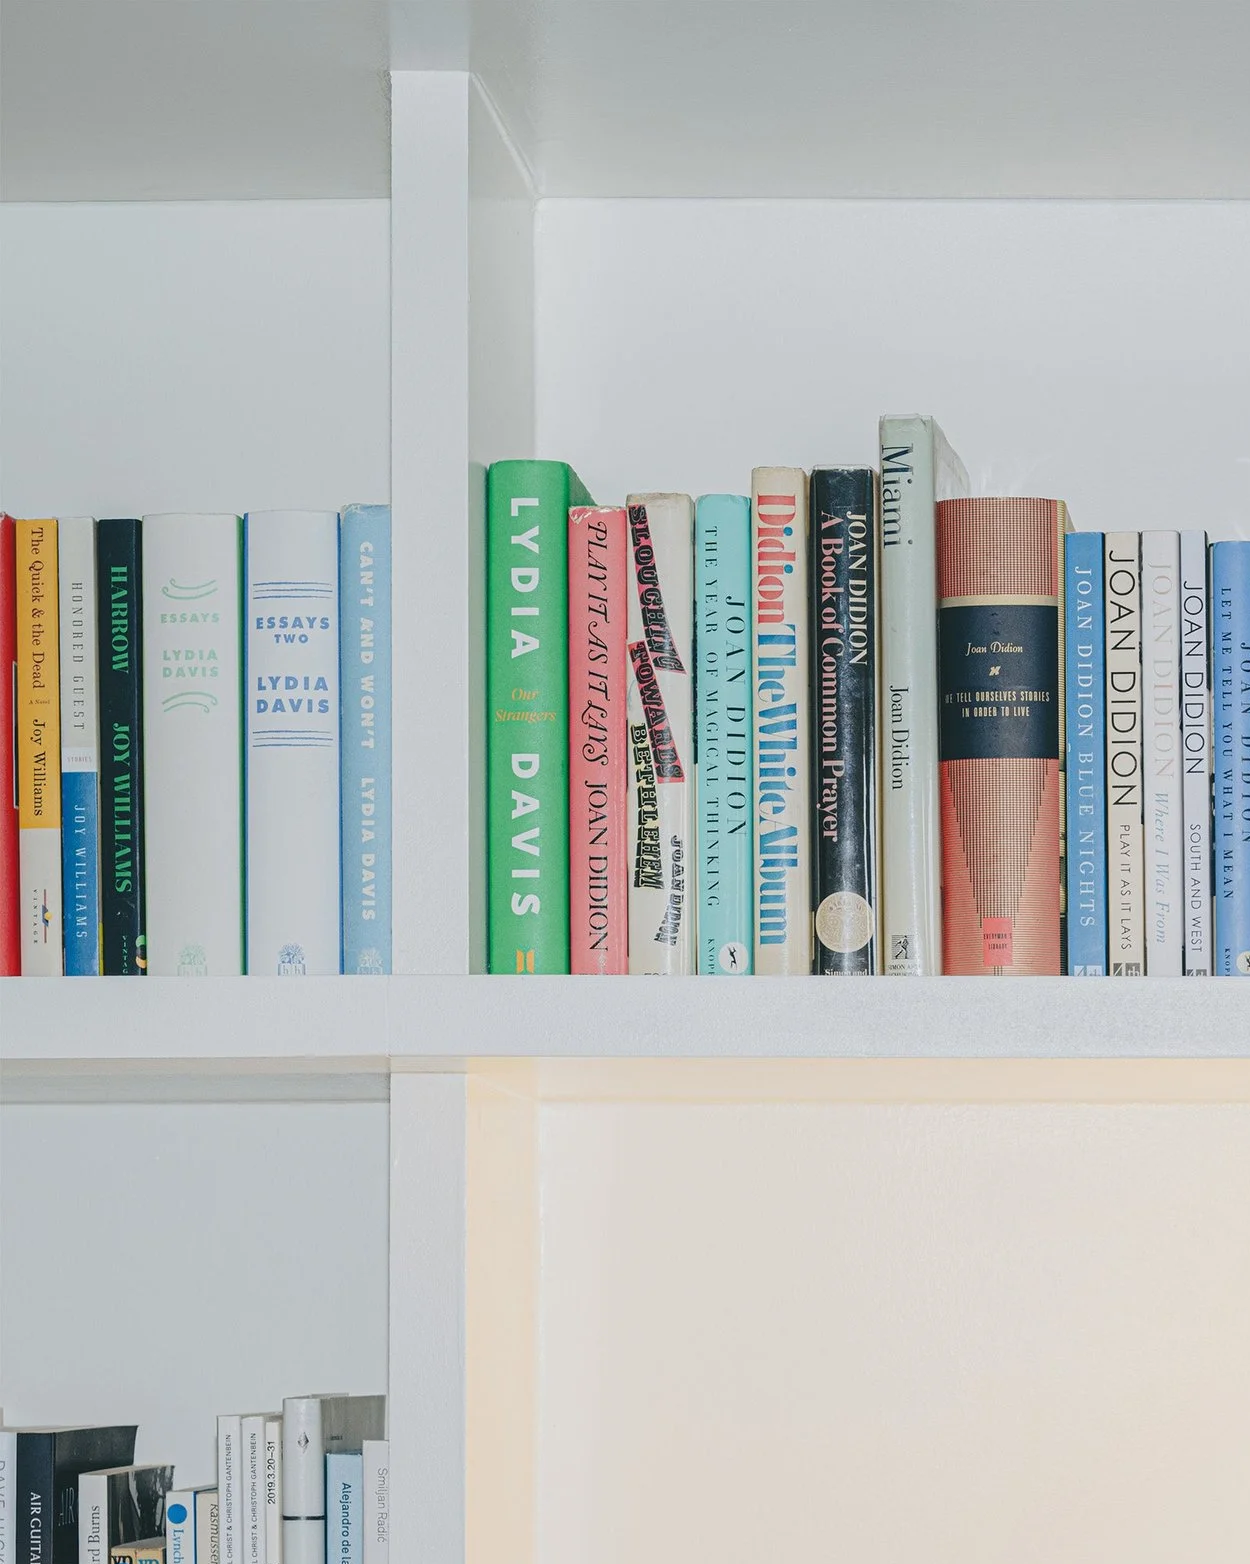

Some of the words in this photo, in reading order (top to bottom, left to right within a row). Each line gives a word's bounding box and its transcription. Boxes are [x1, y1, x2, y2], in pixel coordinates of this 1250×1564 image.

[881, 443, 914, 548] Miami
[820, 511, 844, 530] A
[30, 527, 44, 556] The
[28, 560, 44, 604] Quick
[511, 497, 540, 659] LYDIA
[820, 538, 845, 600] Book
[31, 608, 45, 620] &
[160, 613, 220, 624] ESSAYS
[1108, 550, 1136, 651] JOAN
[31, 624, 45, 651] the
[71, 582, 84, 664] HONORED
[110, 565, 129, 674] HARROW
[255, 616, 331, 630] ESSAYS
[820, 607, 845, 633] of
[162, 650, 219, 661] LYDIA
[274, 633, 309, 644] TWO
[32, 652, 46, 691] Dead
[162, 667, 219, 678] DAVIS
[257, 675, 329, 692] LYDIA
[72, 676, 85, 731] GUEST
[256, 698, 330, 714] DAVIS
[511, 687, 539, 701] Our
[820, 637, 845, 753] Common
[974, 707, 997, 717] ORDER
[1001, 707, 1010, 717] TO
[1013, 706, 1030, 717] LIVE
[976, 691, 1017, 703] OURSELVES
[1020, 691, 1050, 702] STORIES
[31, 719, 46, 745] Joy
[495, 709, 556, 723] Strangers
[112, 722, 131, 767] JOY
[1110, 672, 1138, 806] DIDION
[33, 751, 46, 817] Williams
[816, 760, 845, 843] Prayer
[1078, 753, 1094, 816] BLUE
[114, 773, 131, 893] WILLIAMS
[511, 754, 540, 916] DAVIS
[1190, 823, 1201, 872] SOUTH
[1079, 832, 1095, 927] NIGHTS
[1190, 878, 1202, 911] AND
[1191, 917, 1203, 953] WEST
[30, 1492, 42, 1516] AIR
[88, 1505, 100, 1544] Burns
